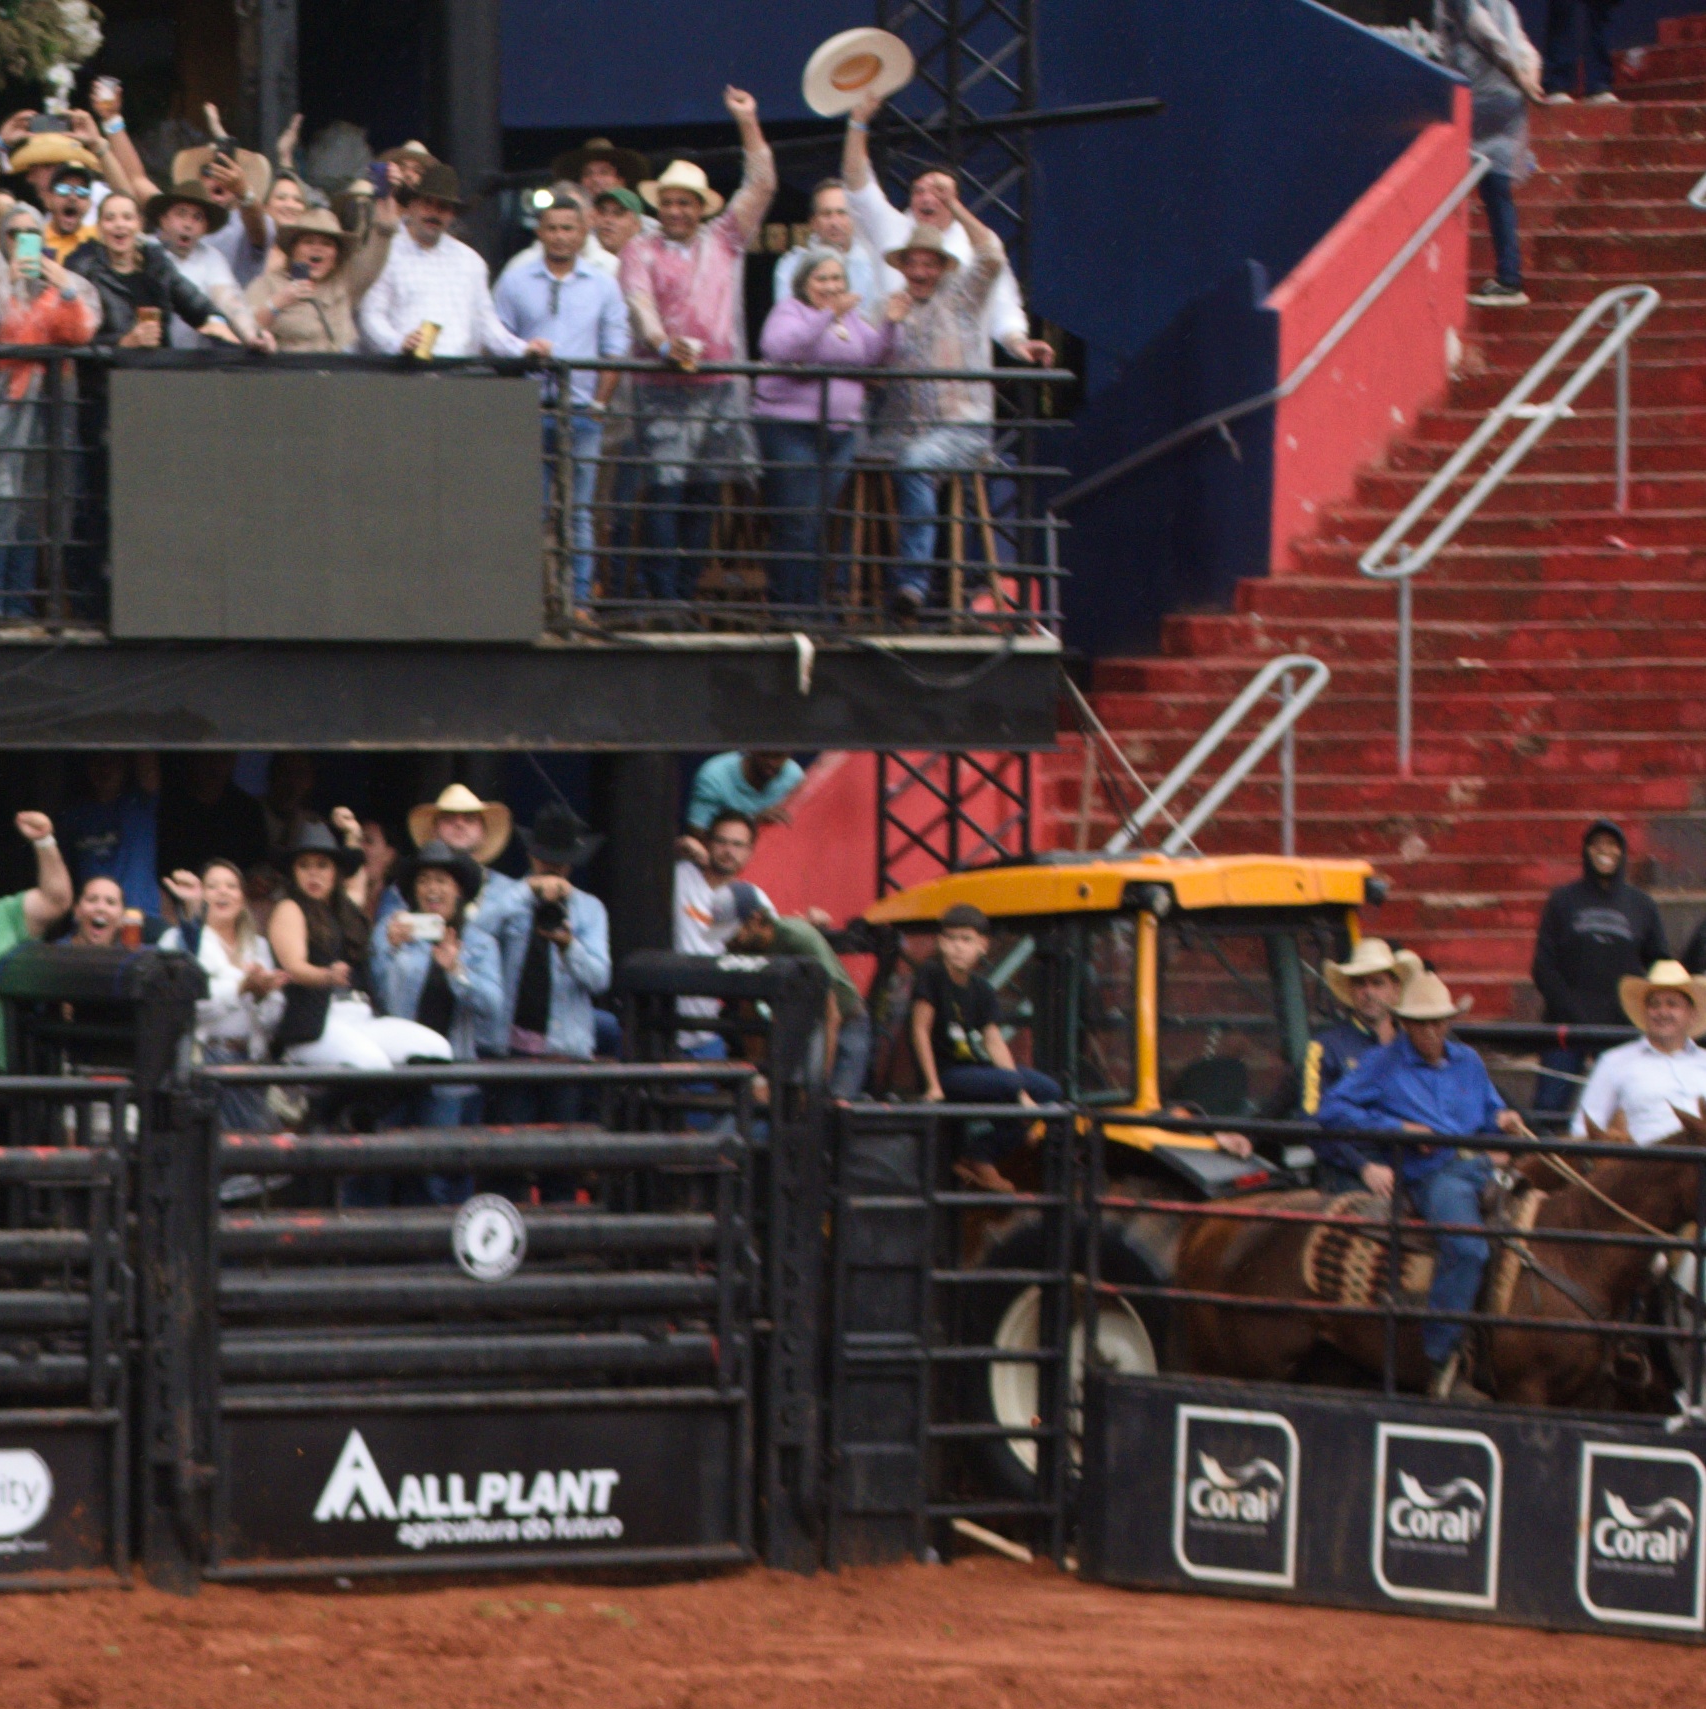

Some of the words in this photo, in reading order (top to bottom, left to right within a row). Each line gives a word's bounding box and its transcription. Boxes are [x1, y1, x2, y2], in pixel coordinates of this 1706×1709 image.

[1189, 1477, 1269, 1522] Coral
[1388, 1497, 1470, 1543] Coral
[1593, 1517, 1676, 1563] Coral
